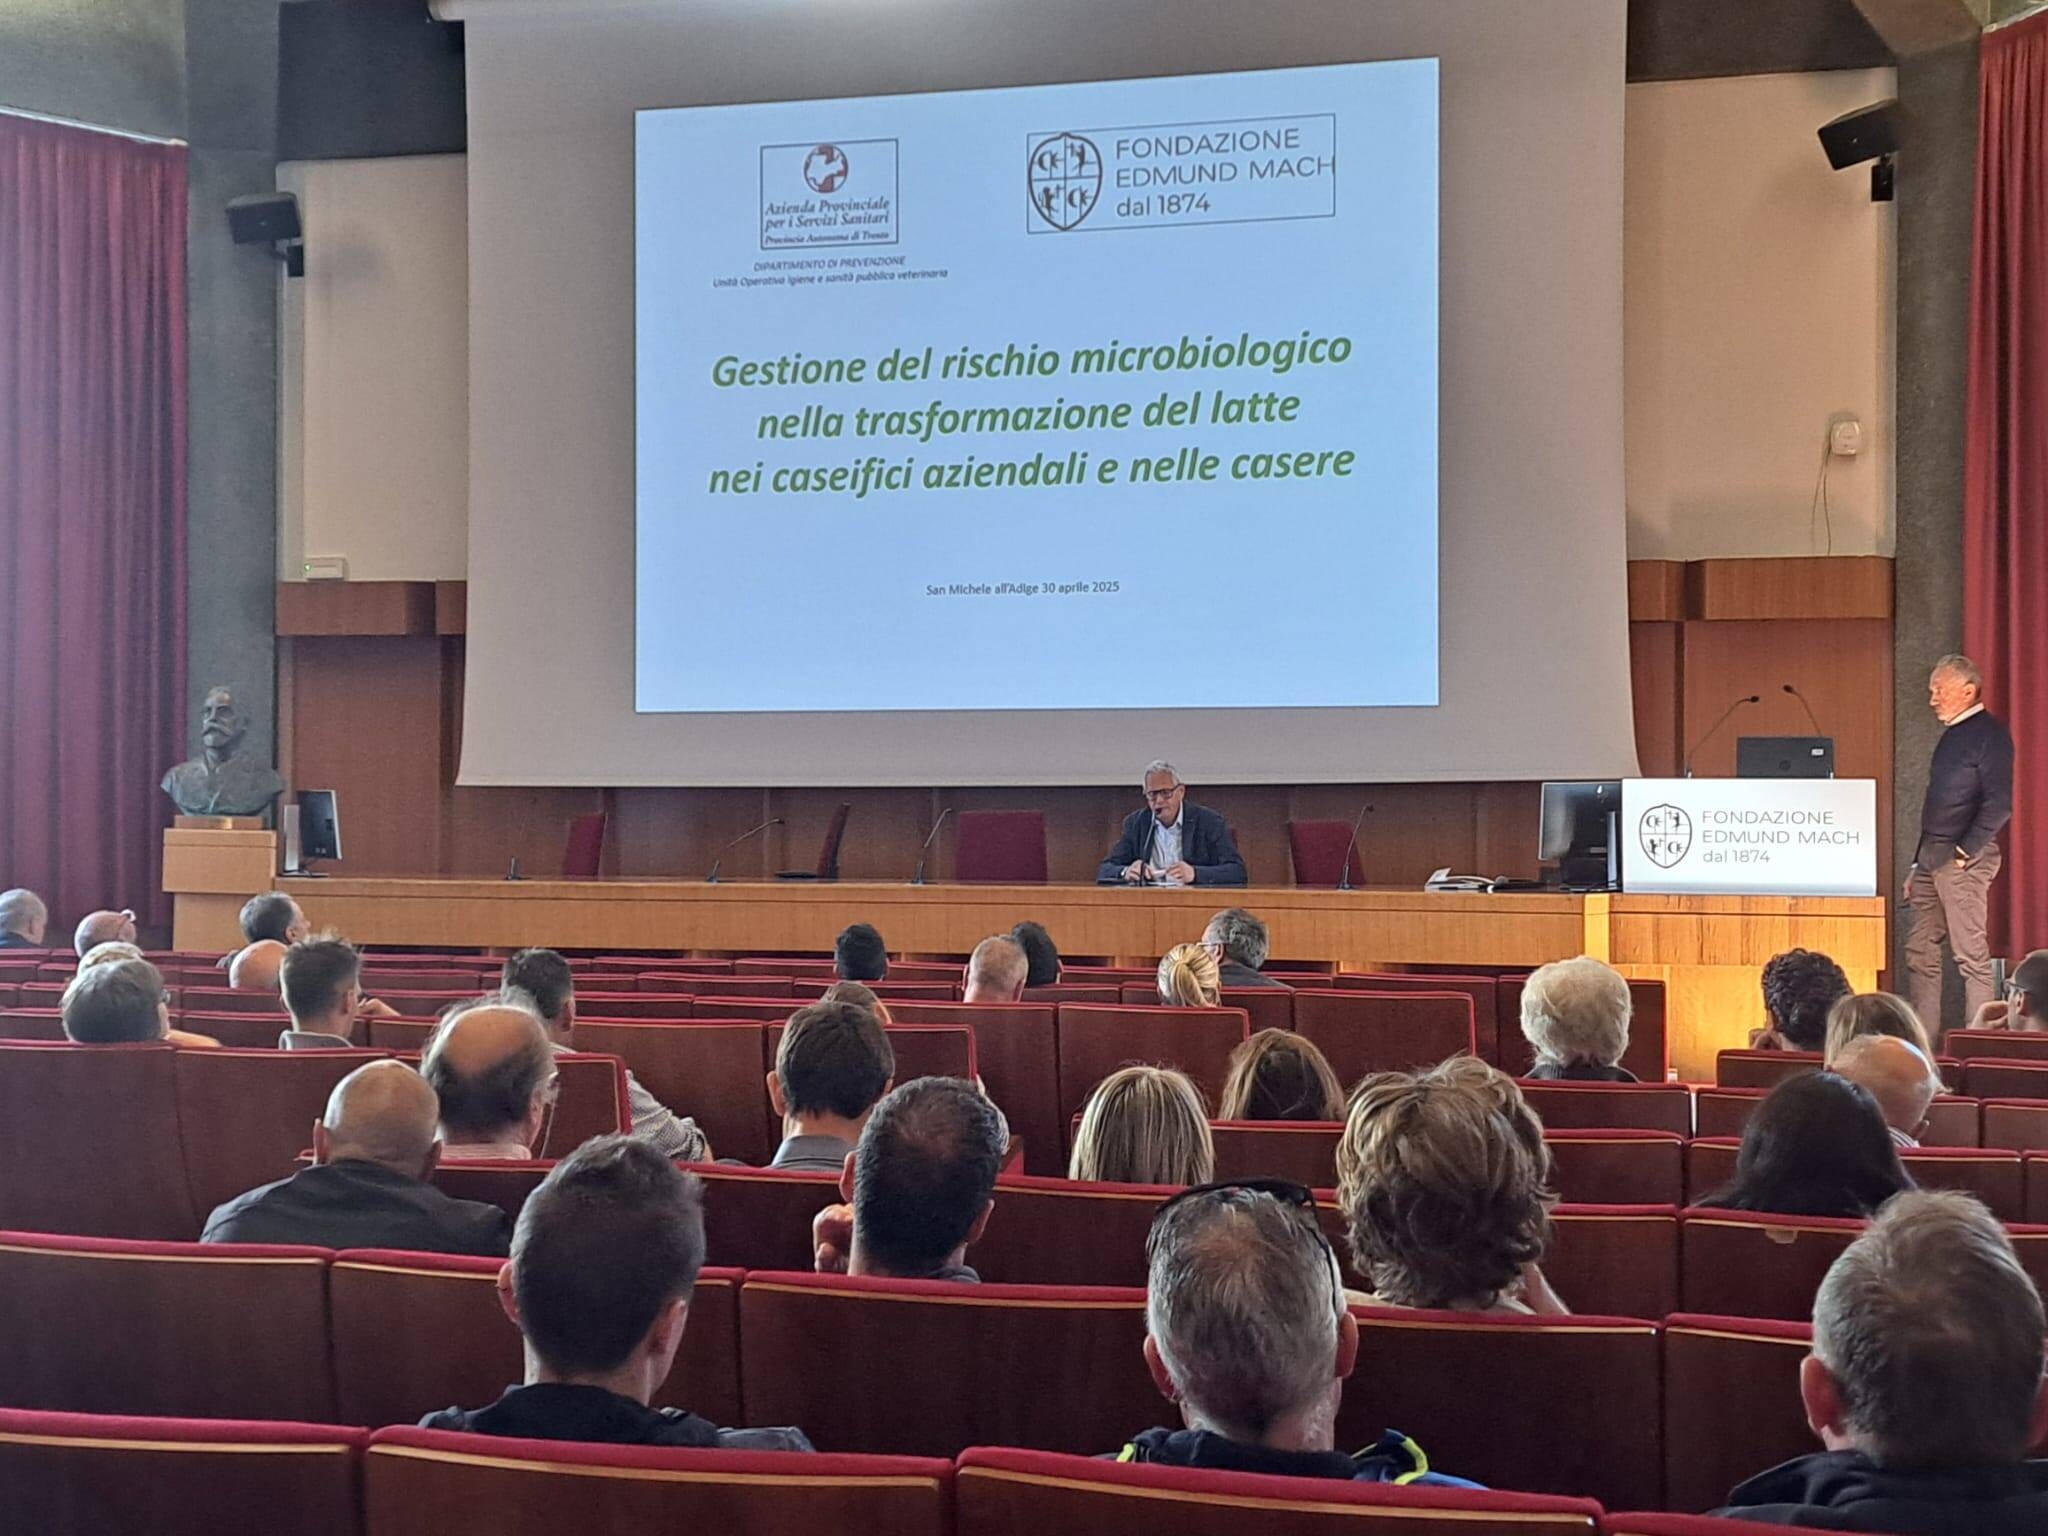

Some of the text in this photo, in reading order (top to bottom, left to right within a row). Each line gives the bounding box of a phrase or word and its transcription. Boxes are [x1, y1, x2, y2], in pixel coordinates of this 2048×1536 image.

[1116, 128, 1300, 159] FONDAZIONE
[1116, 155, 1336, 188] EDMUND MACH
[765, 196, 889, 215] Azienda Provinciale
[1116, 193, 1211, 217] dal 1874
[764, 211, 889, 233] per i Servizi Sanitari
[764, 230, 889, 245] Provincia Autonoma di Trento
[754, 256, 907, 272] DIPARTIMENTO DI PREVENZIONE
[713, 277, 738, 288] Unità
[740, 276, 785, 288] Operativa
[817, 276, 824, 284] e
[826, 272, 853, 283] sanità
[855, 271, 896, 284] pubblica
[898, 269, 948, 281] veterinaria
[712, 330, 1352, 387] Gestione del rischio microbiologico
[757, 390, 1301, 443] nella trasformazione del latte
[709, 447, 1356, 499] nei caseifici aziendali e nelle casere
[926, 584, 946, 596] San
[949, 583, 991, 595] Michele
[1041, 582, 1056, 594] 30
[1058, 581, 1089, 595] aprile
[1092, 580, 1120, 593] 2025
[1702, 810, 1834, 825] FONDAZIONE
[1702, 830, 1860, 845] EDMUND MACH
[1703, 849, 1770, 863] dal 1874
